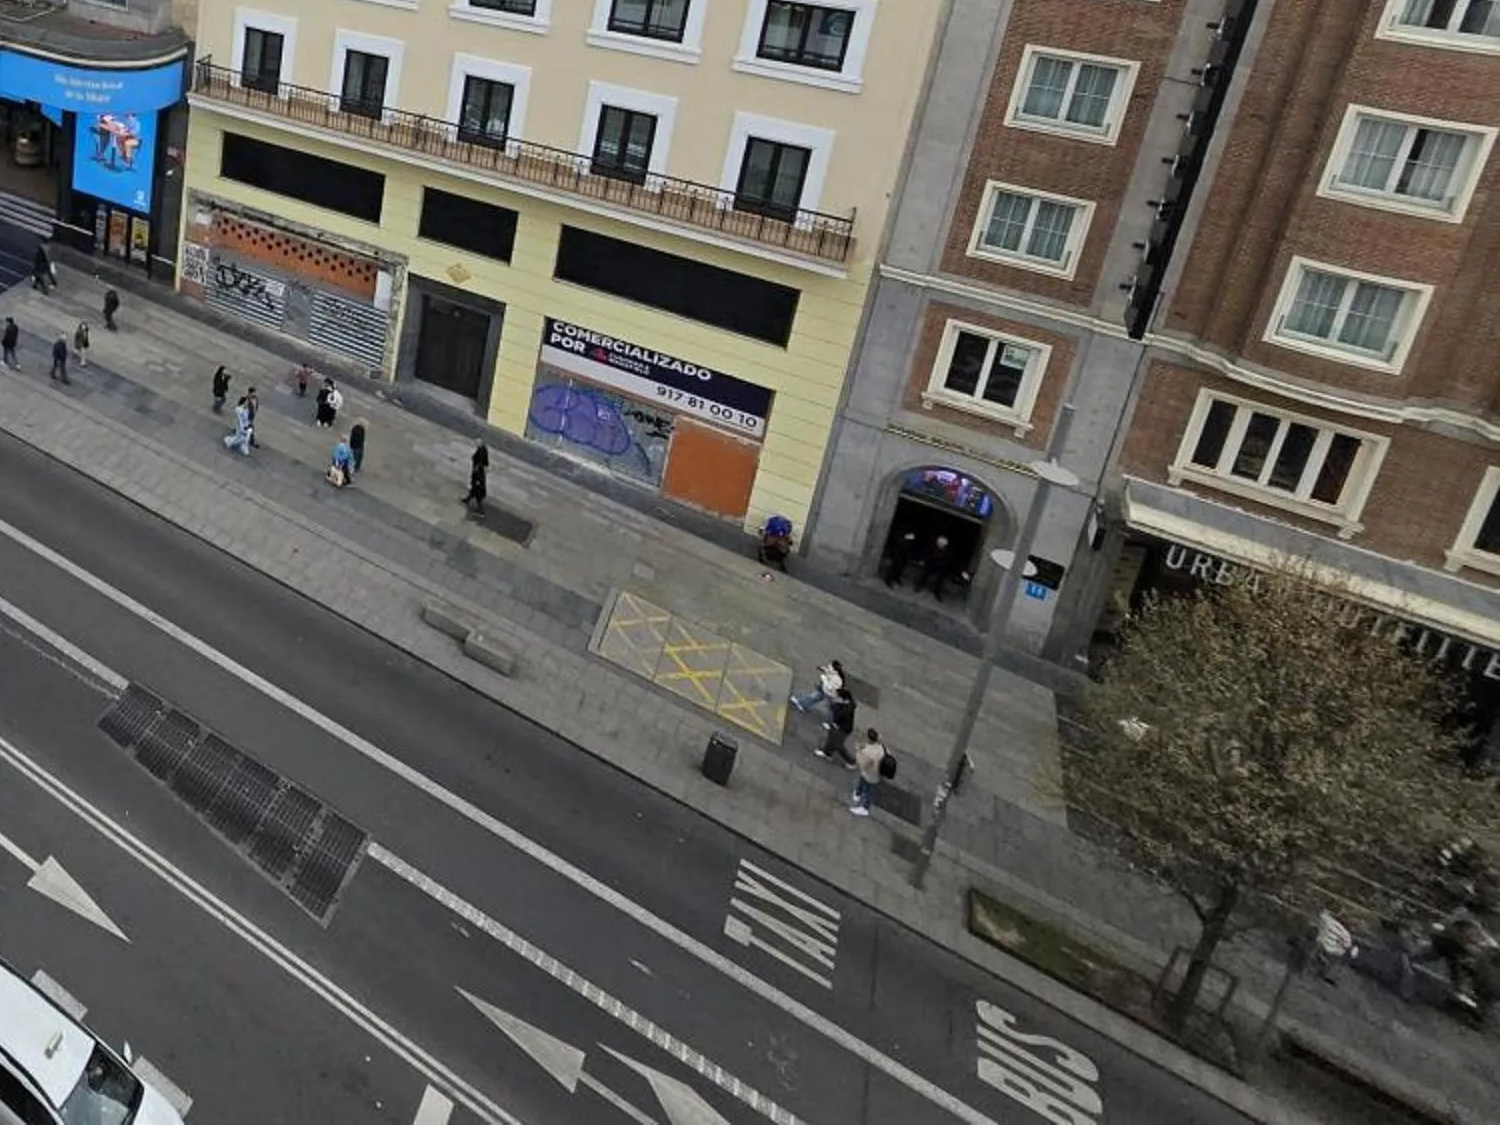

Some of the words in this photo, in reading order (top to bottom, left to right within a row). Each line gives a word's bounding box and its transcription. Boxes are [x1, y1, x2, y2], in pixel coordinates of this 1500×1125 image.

[550, 332, 586, 355] POR
[552, 321, 711, 381] COMERCIALIZADO
[656, 385, 683, 402] 917
[687, 395, 705, 411] 81
[709, 403, 733, 421] 00
[739, 412, 757, 428] 10
[1165, 545, 1268, 597] URBA
[723, 858, 841, 989] TAXI
[976, 999, 1102, 1125] BUS
